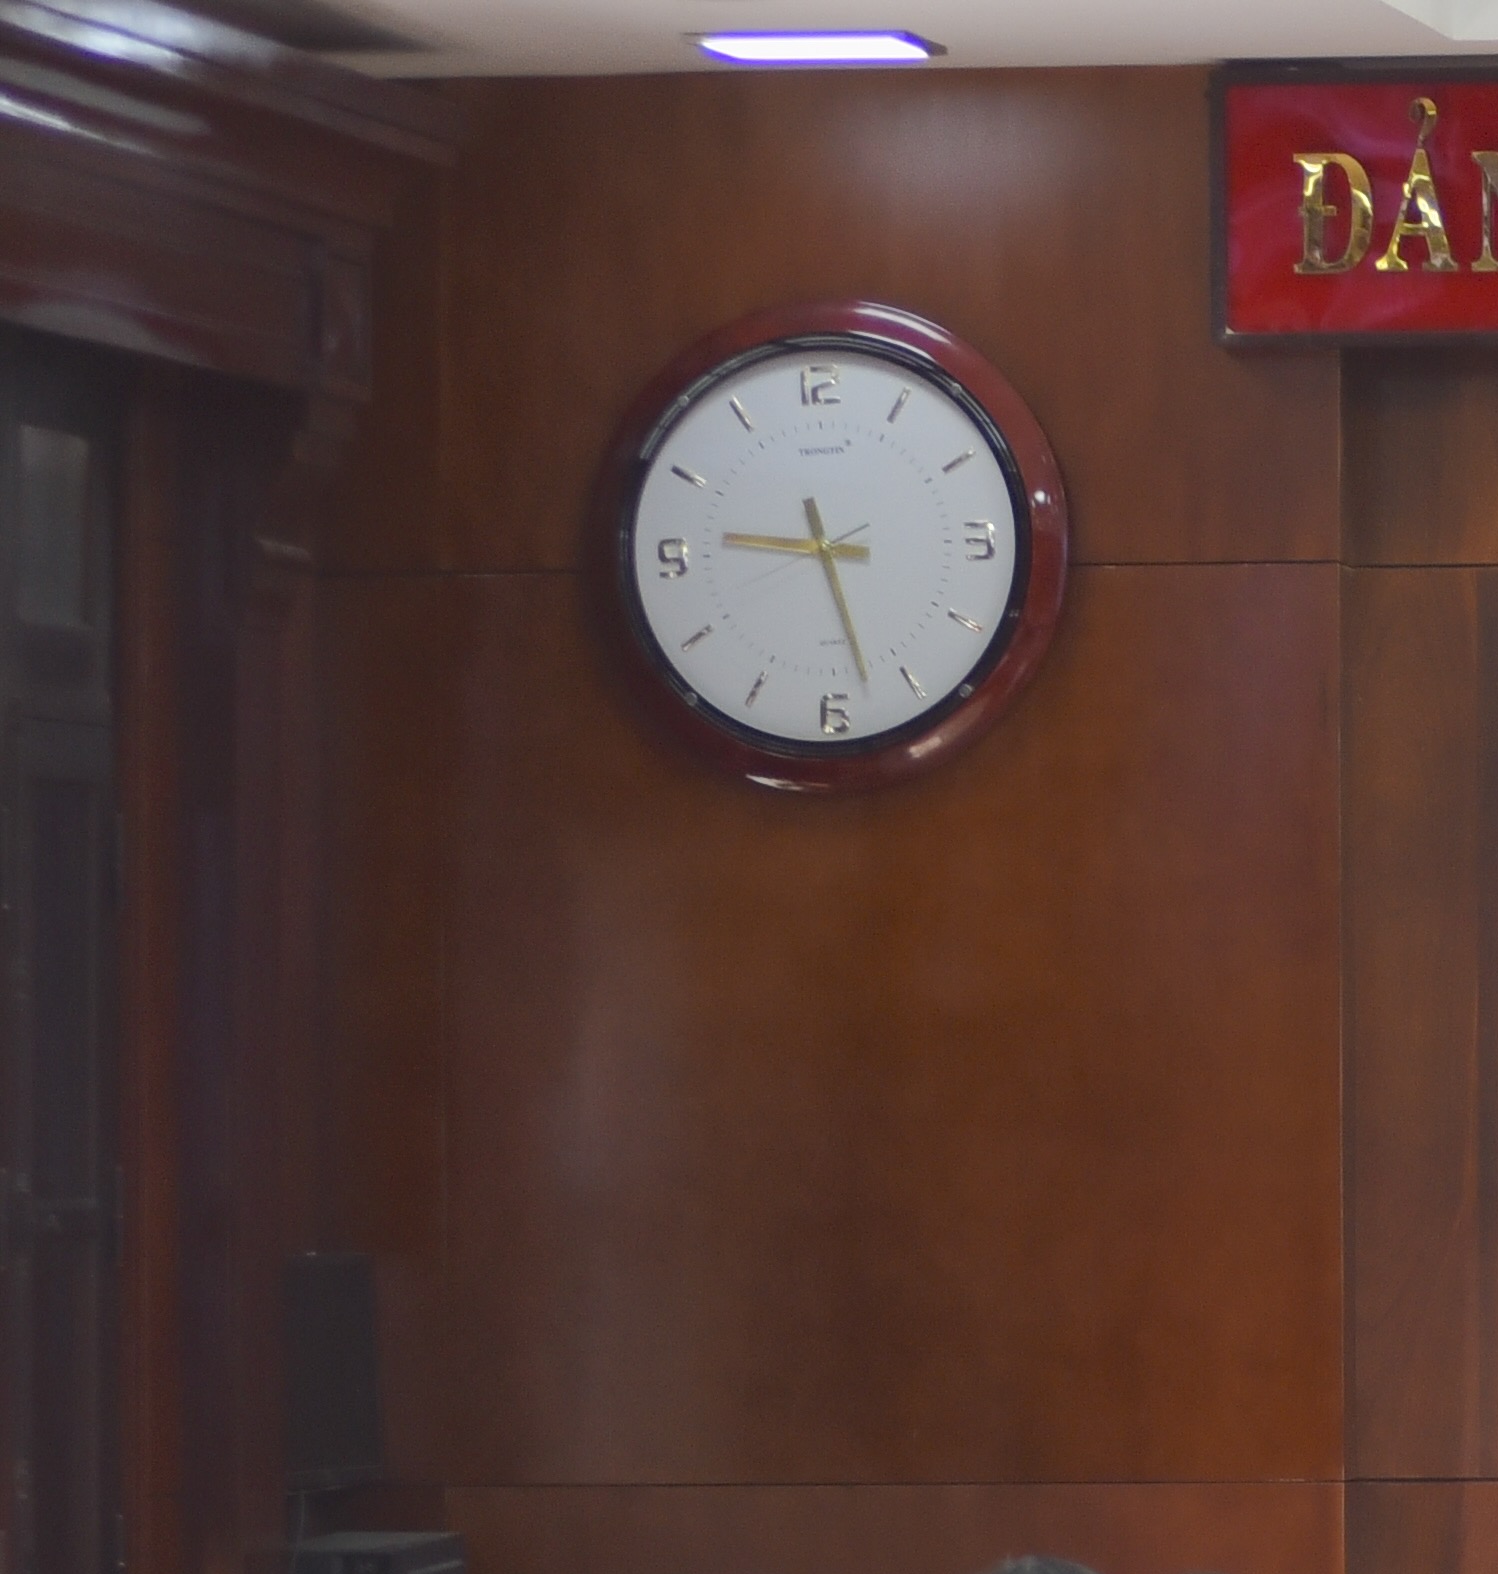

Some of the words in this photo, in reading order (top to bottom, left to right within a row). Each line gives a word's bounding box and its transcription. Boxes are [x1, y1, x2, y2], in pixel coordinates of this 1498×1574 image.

[800, 363, 842, 407] 12
[657, 537, 690, 580] 9
[963, 519, 997, 562] 3
[819, 692, 851, 735] 6
